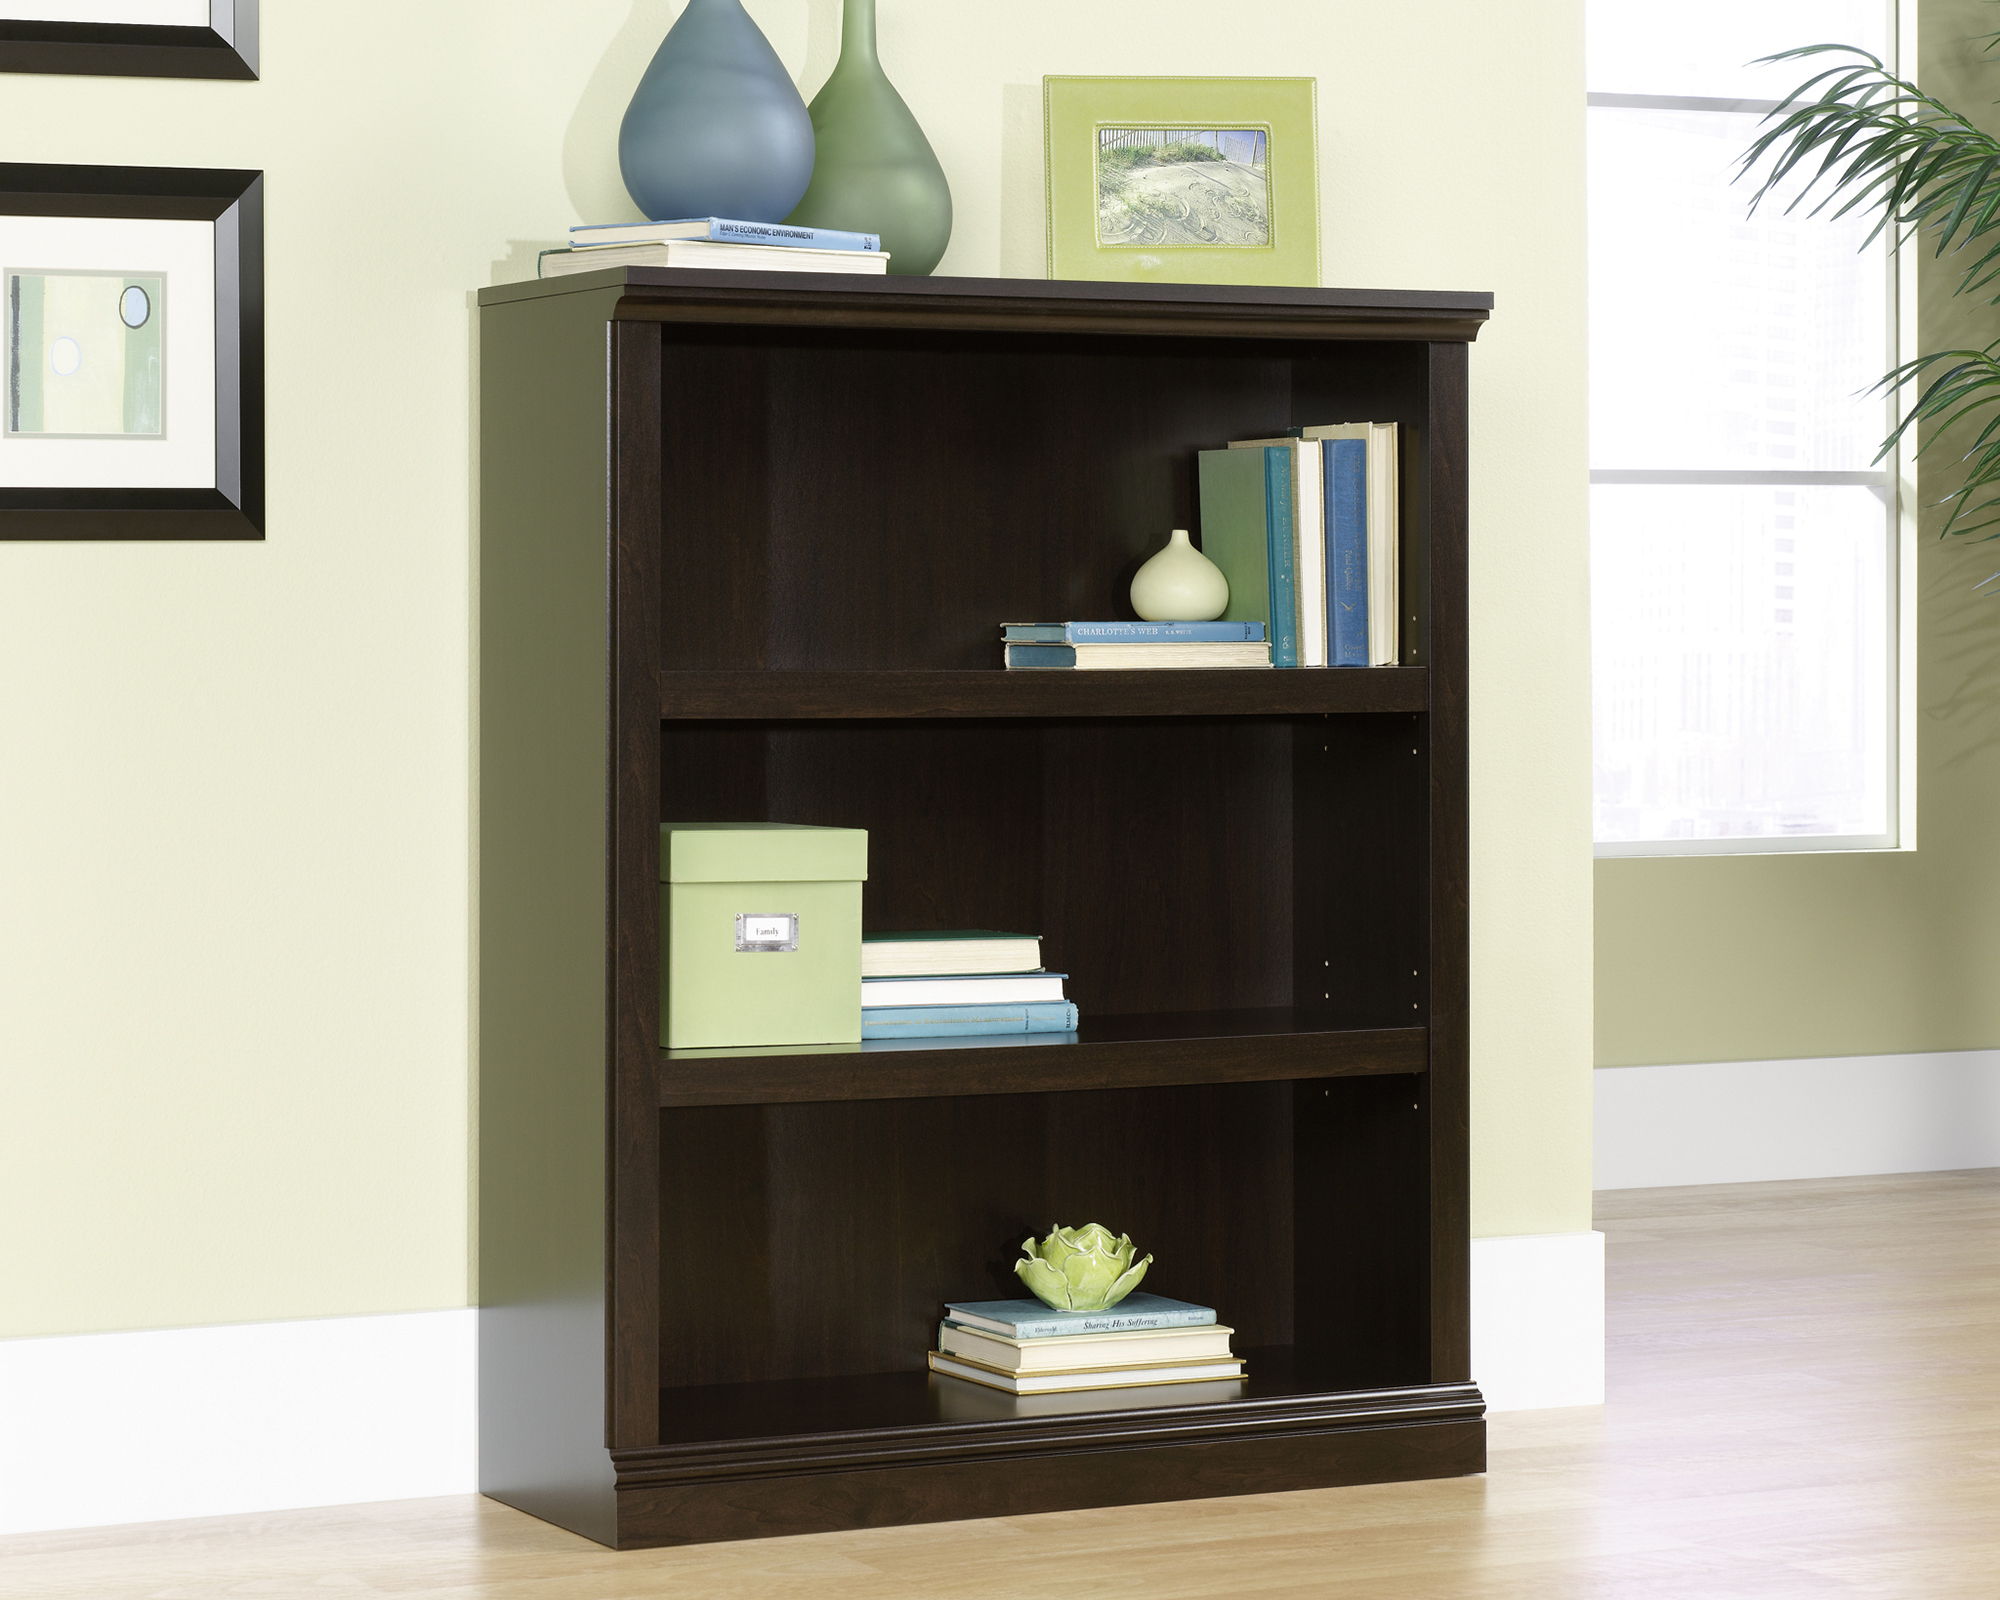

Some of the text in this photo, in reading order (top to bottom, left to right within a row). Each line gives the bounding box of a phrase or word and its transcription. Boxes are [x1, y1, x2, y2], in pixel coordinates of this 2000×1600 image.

[720, 223, 739, 233] MAN'S
[740, 225, 772, 236] ECONOMIC
[772, 228, 815, 240] ENVIRONMENT
[1077, 626, 1159, 636] CHARLOTTE'S WEB
[756, 927, 779, 937] Family
[1083, 1318, 1158, 1331] Sharing His Suffering
